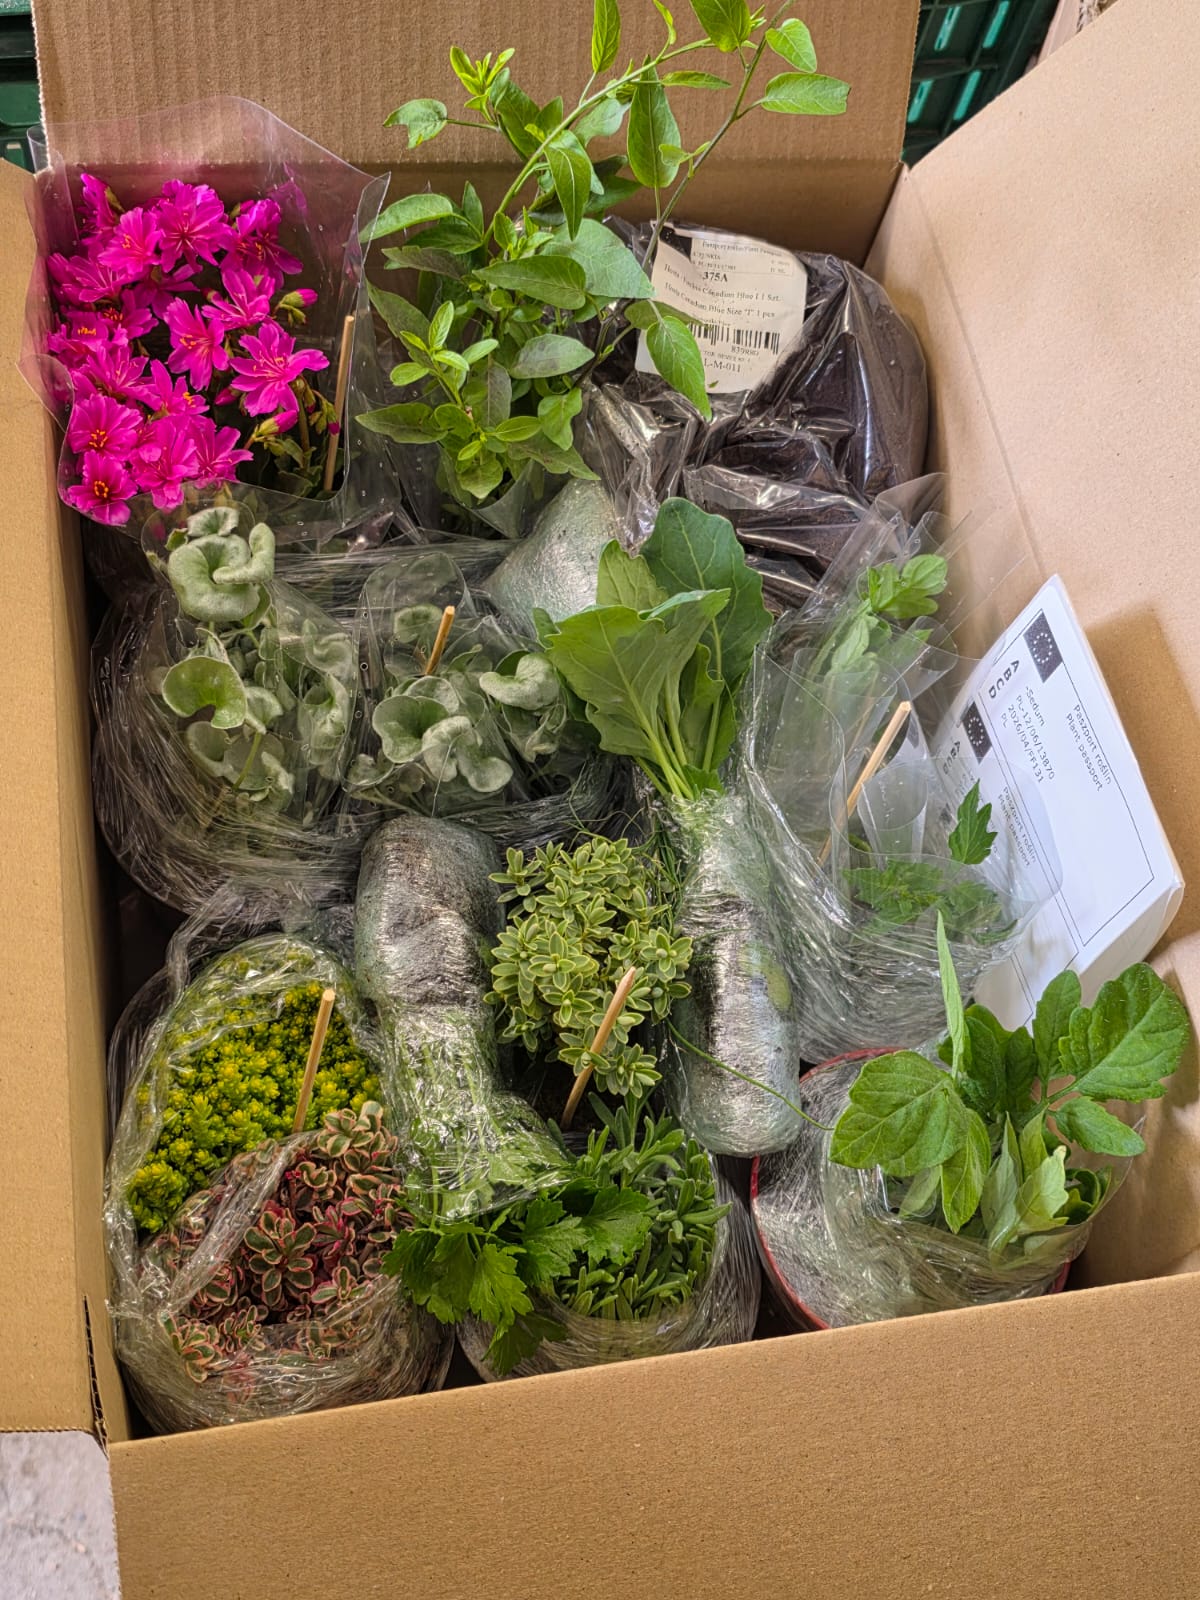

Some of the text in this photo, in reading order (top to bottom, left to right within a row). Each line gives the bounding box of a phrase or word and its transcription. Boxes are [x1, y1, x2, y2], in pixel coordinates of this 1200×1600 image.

[702, 271, 728, 282] 375A
[736, 291, 754, 300] Blue
[708, 304, 725, 314] Blue
[726, 307, 742, 316] Size
[703, 358, 741, 373] L-M-011
[1010, 659, 1020, 673] A
[1003, 667, 1012, 681] B
[996, 677, 1005, 691] C
[988, 685, 997, 699] D
[1073, 704, 1112, 785] Paszport roślin
[1066, 712, 1103, 792] Plant passport
